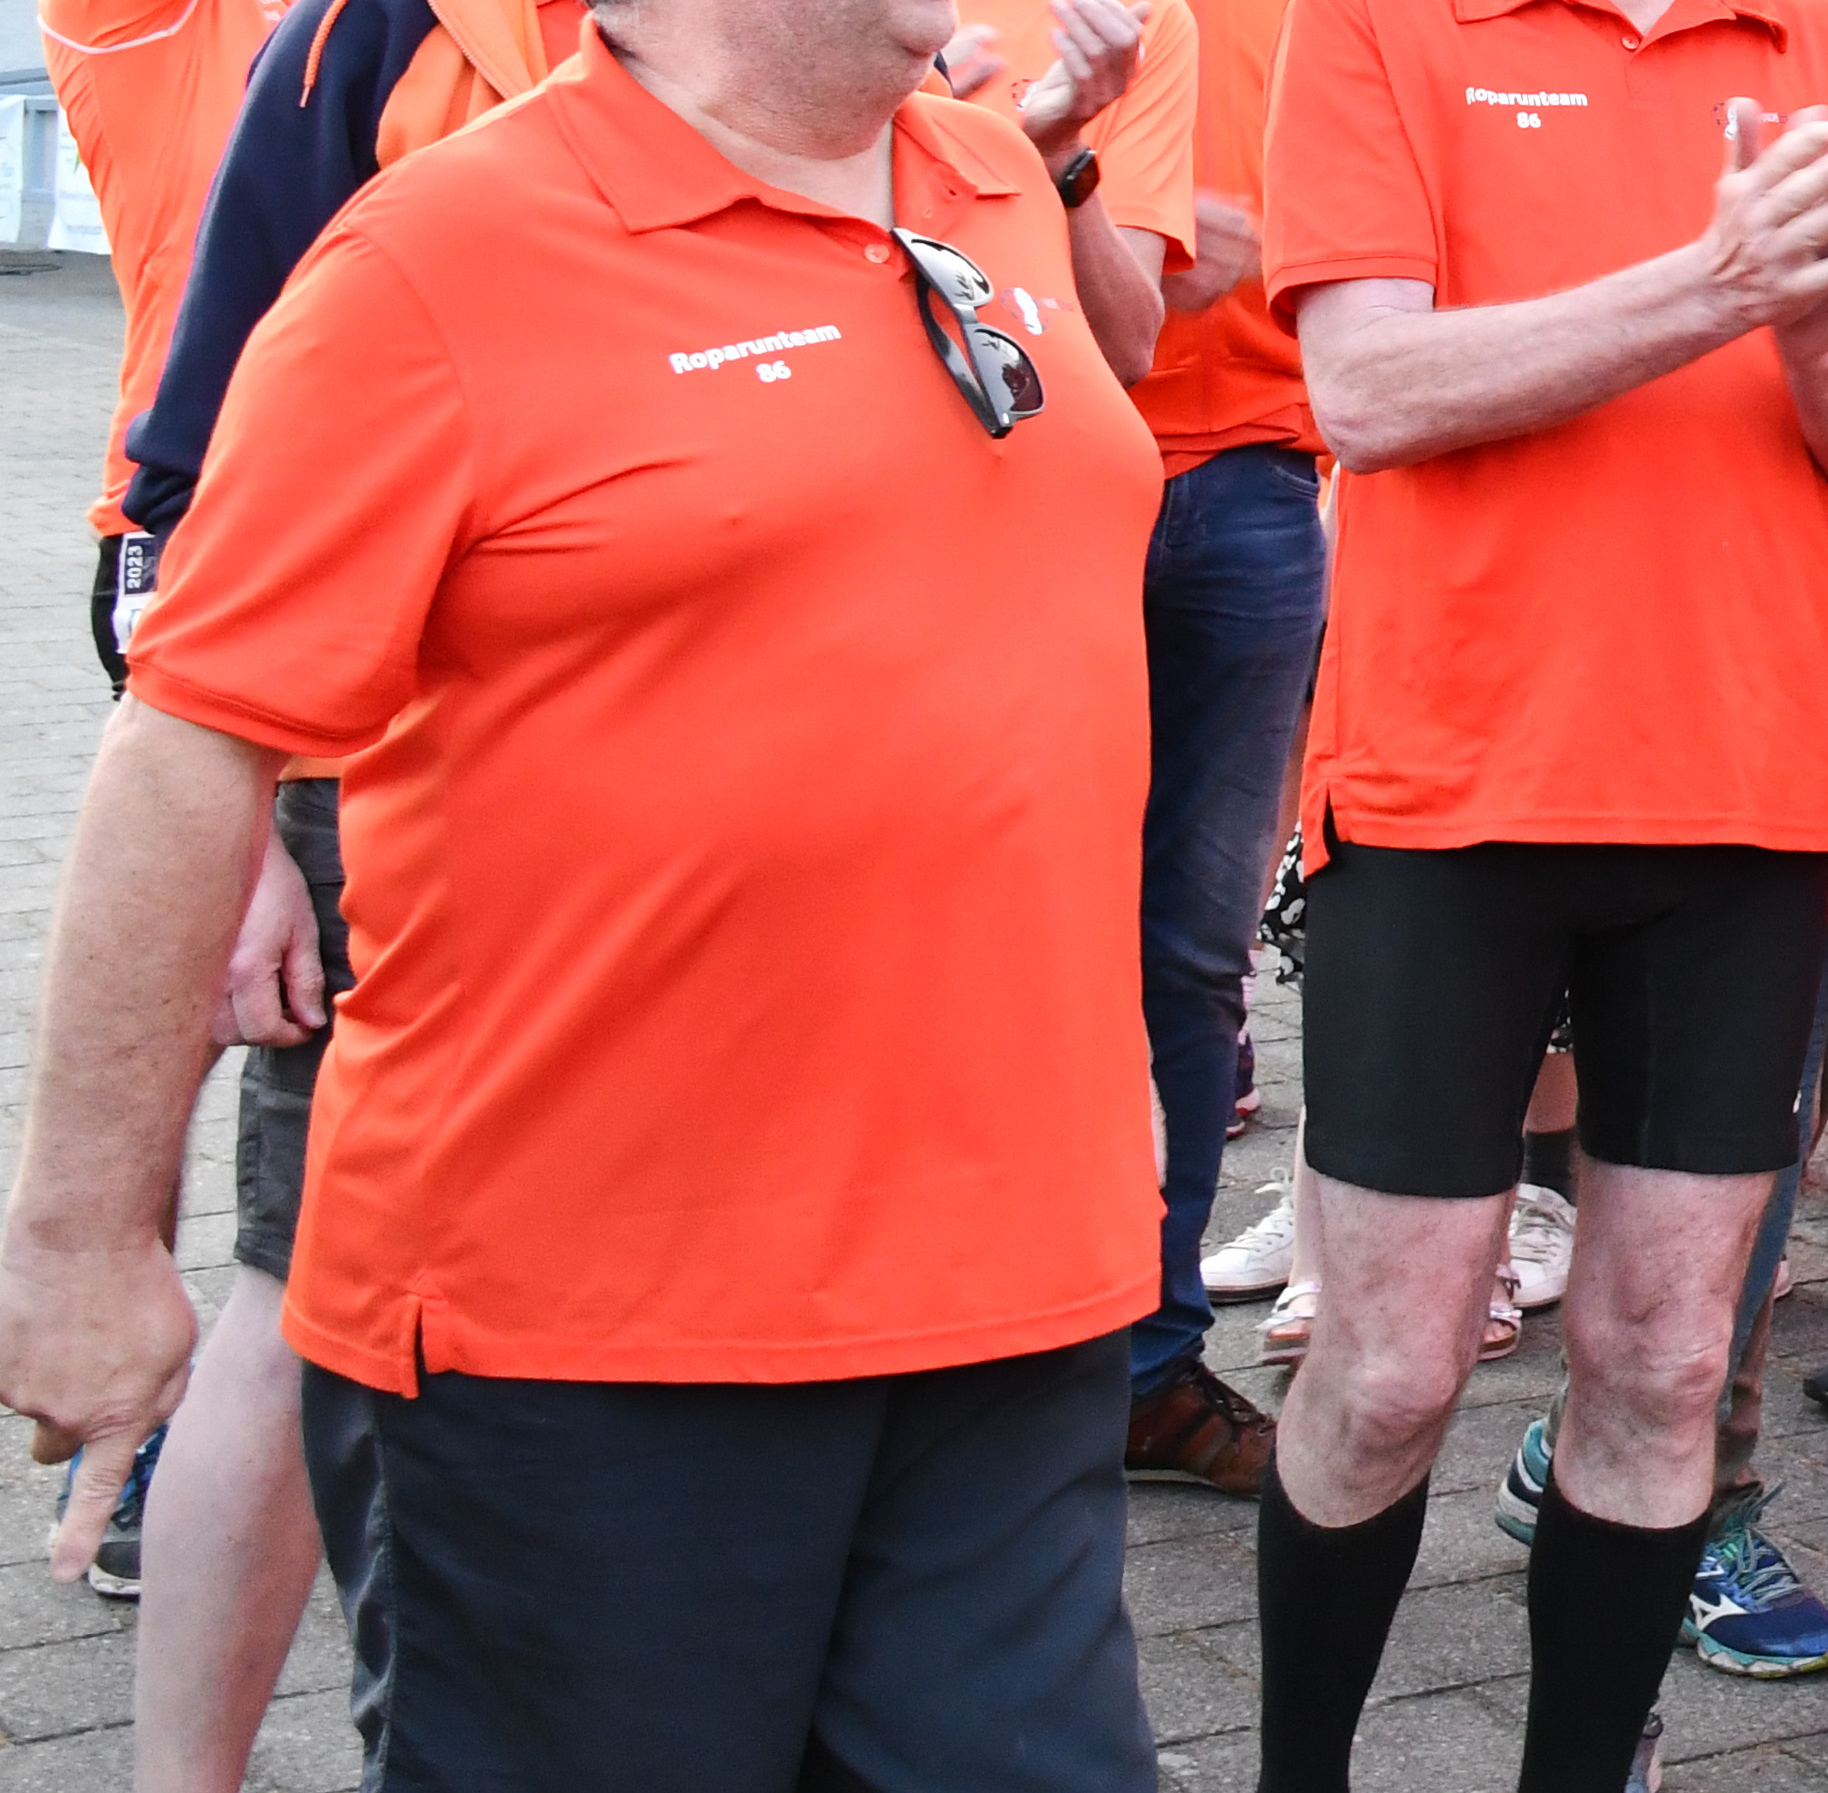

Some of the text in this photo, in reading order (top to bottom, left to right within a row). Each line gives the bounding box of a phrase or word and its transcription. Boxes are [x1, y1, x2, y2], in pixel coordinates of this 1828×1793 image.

[1466, 86, 1588, 107] Roparunteam
[1516, 112, 1541, 129] 86
[669, 324, 842, 374] Roparunteam
[756, 360, 791, 383] 86
[126, 545, 144, 589] 2023
